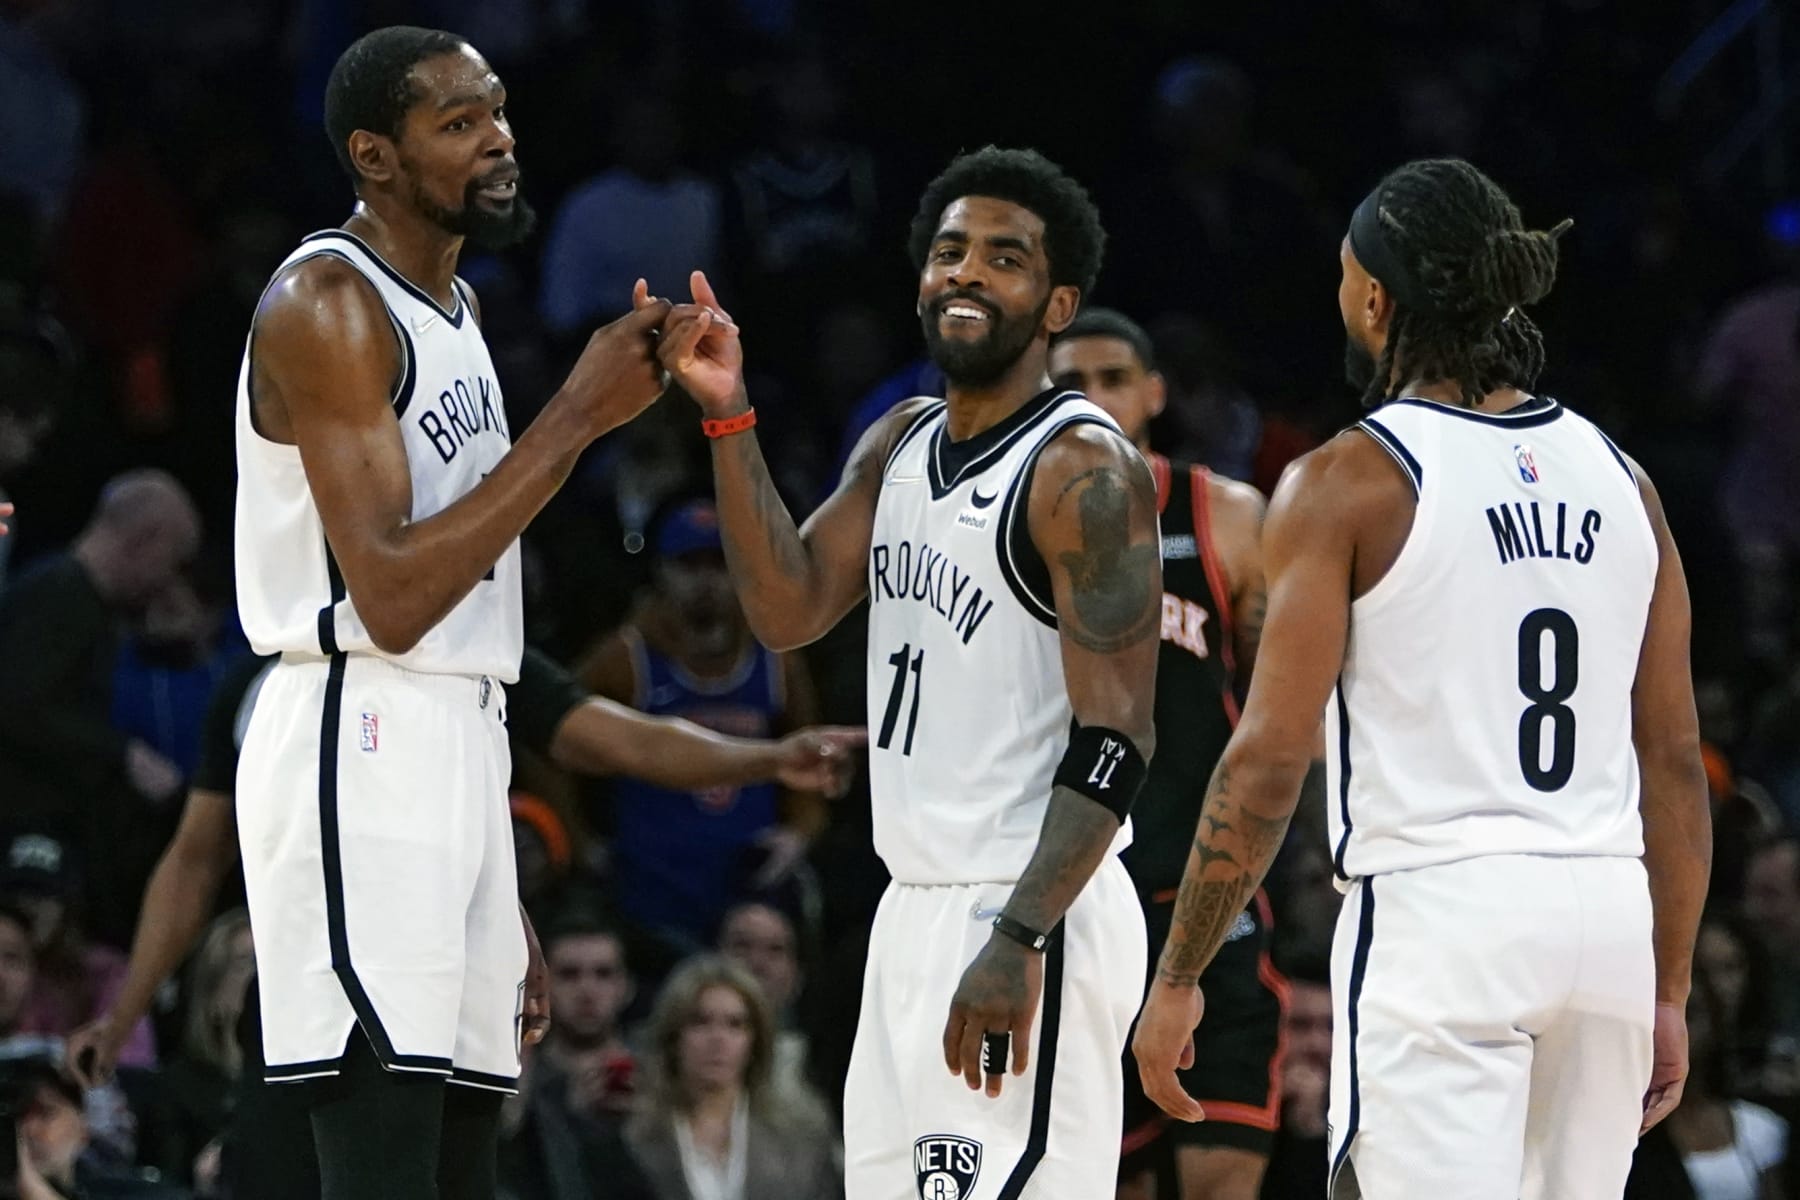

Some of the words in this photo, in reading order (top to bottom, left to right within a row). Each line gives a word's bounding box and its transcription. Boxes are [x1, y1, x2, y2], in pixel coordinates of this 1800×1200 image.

[1486, 502, 1601, 565] MILLS
[873, 540, 994, 646] ROOKLYN
[1160, 591, 1209, 659] RK
[877, 643, 925, 757] 11
[1518, 607, 1579, 793] 8
[1087, 753, 1117, 789] 11
[1100, 737, 1126, 761] KAI
[915, 1140, 976, 1175] NETS
